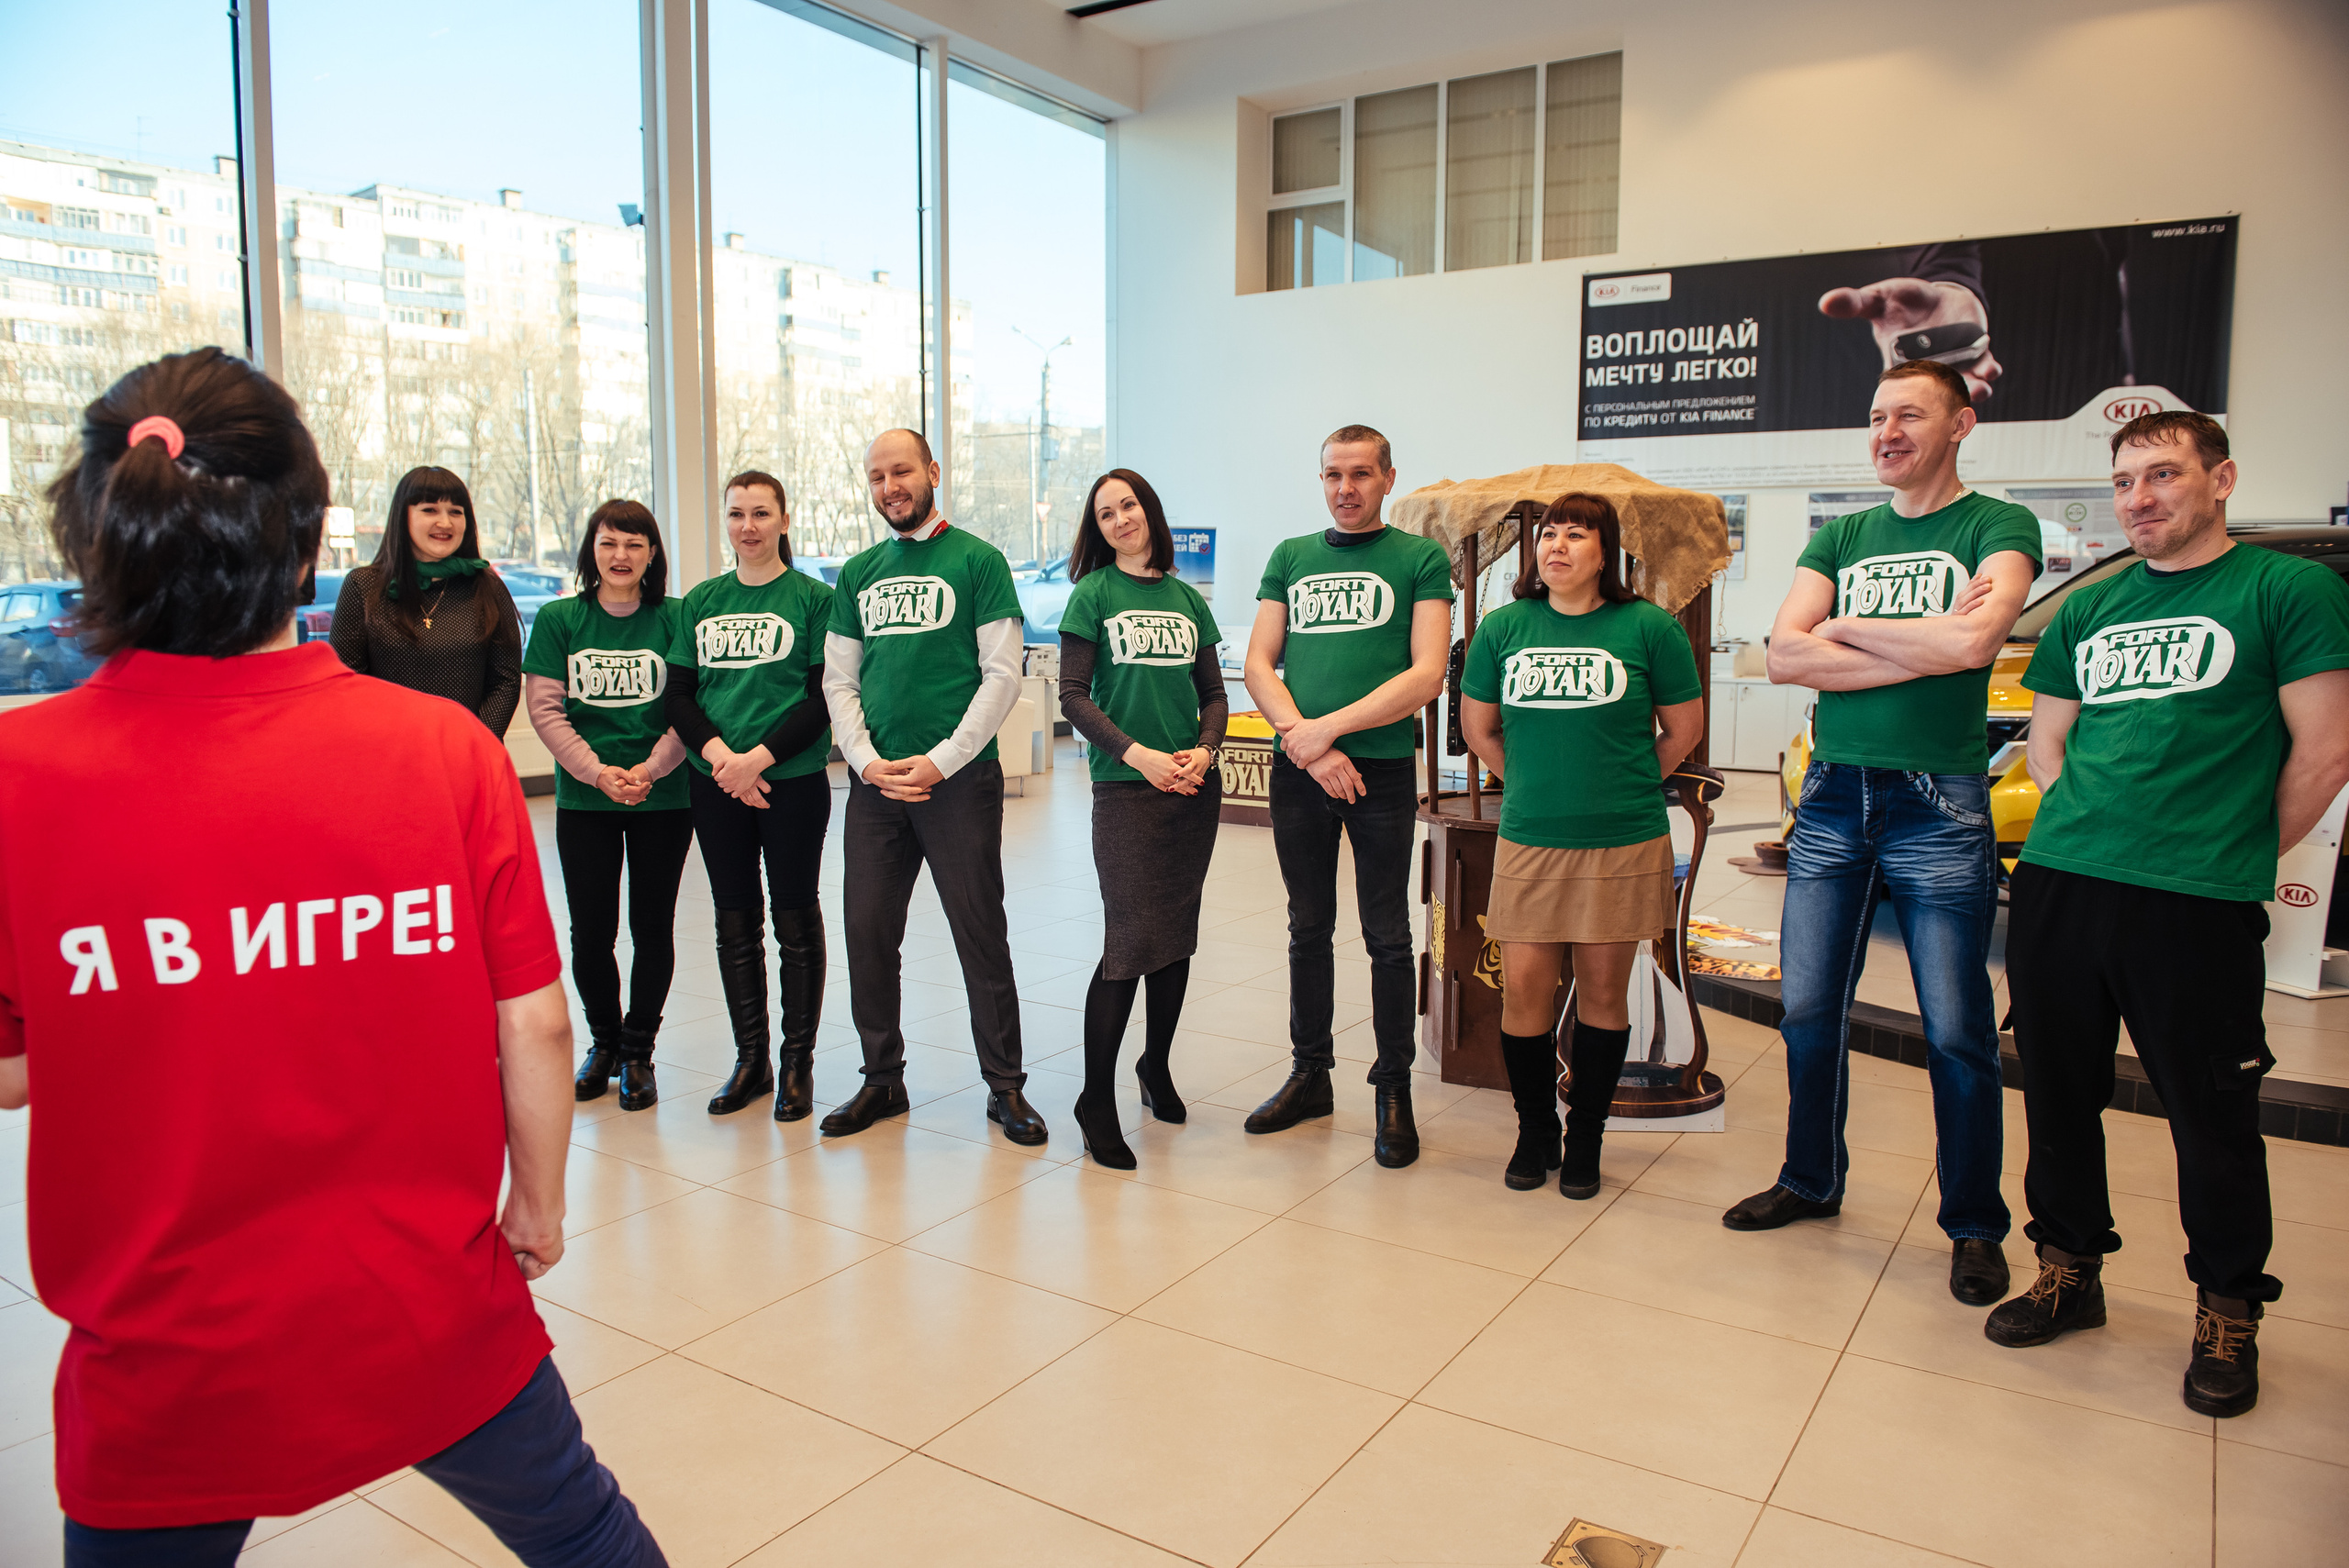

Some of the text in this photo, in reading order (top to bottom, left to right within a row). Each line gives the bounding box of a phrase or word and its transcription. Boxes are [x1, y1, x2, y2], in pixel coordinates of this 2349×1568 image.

[2151, 224, 2225, 239] www.kia.ru
[1586, 317, 1759, 360] ВОПЛОЩАЙ
[1586, 356, 1757, 388] МЕЧТУ ЛЕГКО!
[1584, 395, 1755, 414] С ПЕРСОНАЛЬНЫМ ПРЕДЛОЖЕНИЕМ
[1584, 408, 1755, 428] ПО КРЕДИТУ ОТ KIA FINANCE
[1867, 560, 1931, 578] FORT
[879, 583, 927, 596] FORT
[1308, 579, 1362, 594] FORT
[1837, 561, 1972, 617] BOYARD
[857, 583, 956, 637] BOYARD
[1287, 579, 1395, 633] BOYARD
[717, 618, 766, 630] FORT
[1131, 617, 1177, 628] FORT
[696, 618, 795, 667] BOYARD
[1104, 617, 1198, 665] BOYARD
[2109, 627, 2187, 649] FORT
[590, 655, 641, 668] FORT
[1531, 654, 1591, 666] FORT
[2075, 627, 2235, 705] BOYARD
[568, 653, 667, 700] BOYARD
[1502, 654, 1628, 705] BOYARD
[1224, 749, 1271, 763] FORT
[60, 884, 455, 995] Я В ИГРЕ!
